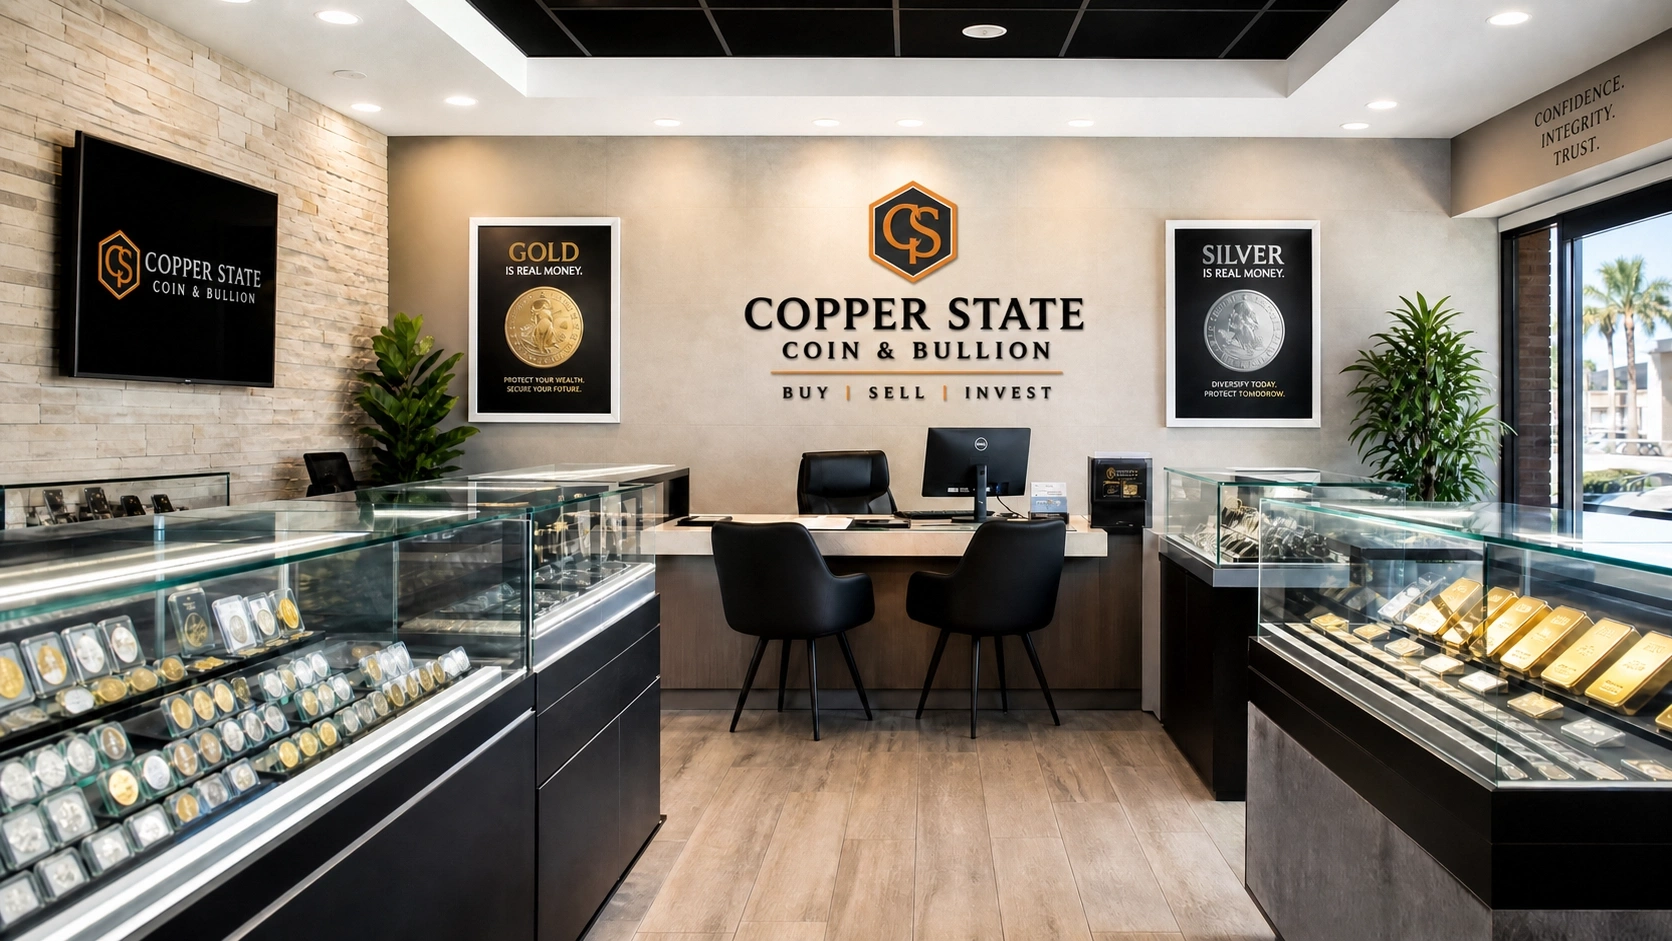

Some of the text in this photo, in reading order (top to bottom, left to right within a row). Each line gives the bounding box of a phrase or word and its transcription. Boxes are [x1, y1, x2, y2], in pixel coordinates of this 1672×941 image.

[1534, 75, 1625, 127] CONFIDENCE.
[1541, 104, 1616, 149] INTEGRITY.
[1553, 136, 1600, 166] TRUST.
[508, 241, 580, 263] GOLD
[1202, 244, 1285, 265] SILVER
[145, 251, 262, 288] COPPER STATE
[505, 265, 583, 276] IS REAL MONEY.
[1203, 268, 1285, 278] IS REAL MONEY.
[152, 280, 255, 304] COIN & BULLION
[744, 297, 1085, 331] COPPER STATE
[782, 341, 1051, 360] COIN & BULLION
[533, 385, 552, 393] YOUR
[535, 376, 554, 384] YOUR
[782, 386, 1052, 400] BUY SELL INVEST
[1204, 390, 1237, 398] PROTECT
